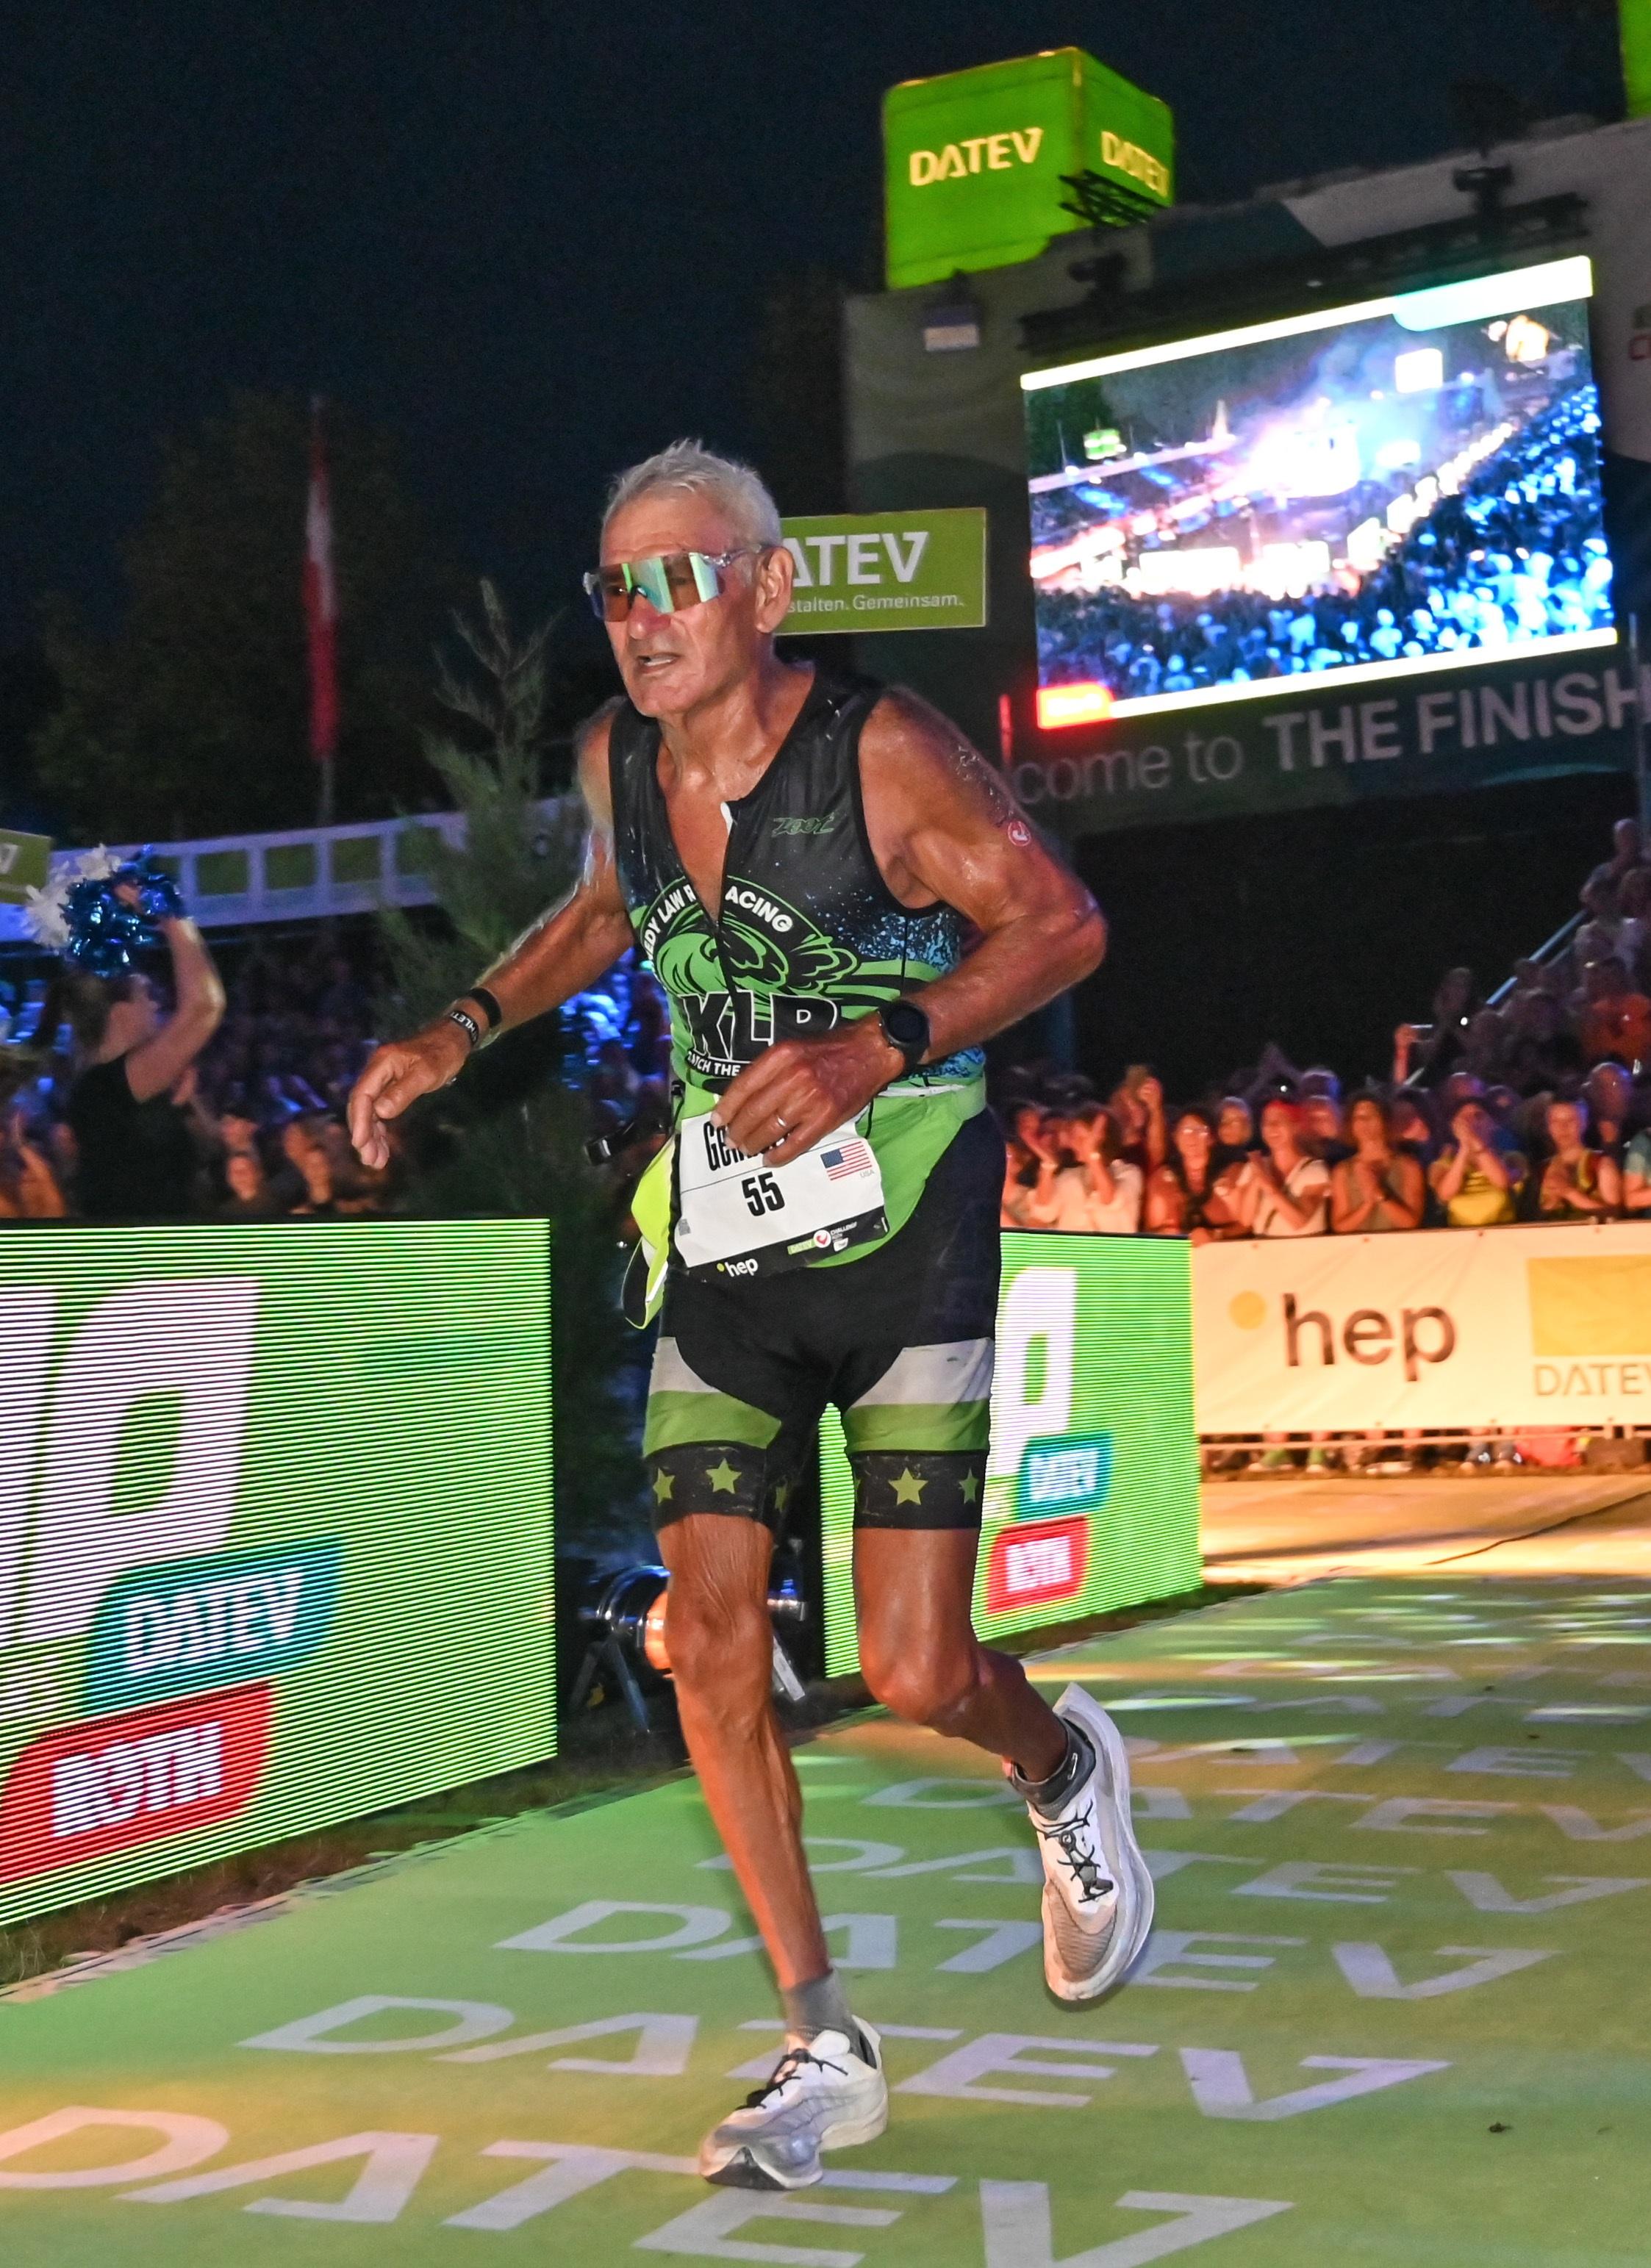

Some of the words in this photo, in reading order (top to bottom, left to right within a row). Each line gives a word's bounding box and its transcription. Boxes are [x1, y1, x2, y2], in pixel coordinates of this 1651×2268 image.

[909, 126, 1043, 186] DATEV
[1100, 130, 1170, 198] DATEV
[782, 531, 928, 587] ATEV
[787, 597, 850, 614] stalten.
[852, 593, 964, 611] Gemeinsam.
[1013, 744, 1173, 805] come
[1183, 732, 1244, 782] to
[1261, 699, 1403, 772] THE
[1417, 664, 1651, 754] FINISH
[656, 889, 686, 924] LAW
[714, 1062, 741, 1077] THE
[741, 1171, 786, 1216] 55
[724, 1258, 759, 1278] hep
[1282, 1293, 1457, 1382] hep
[1534, 1363, 1651, 1396] DATE
[126, 1566, 303, 1679] DATEV
[51, 1719, 223, 1839] ROTH
[237, 1994, 1454, 2122] DATEV
[0, 2105, 1296, 2268] DATEV
